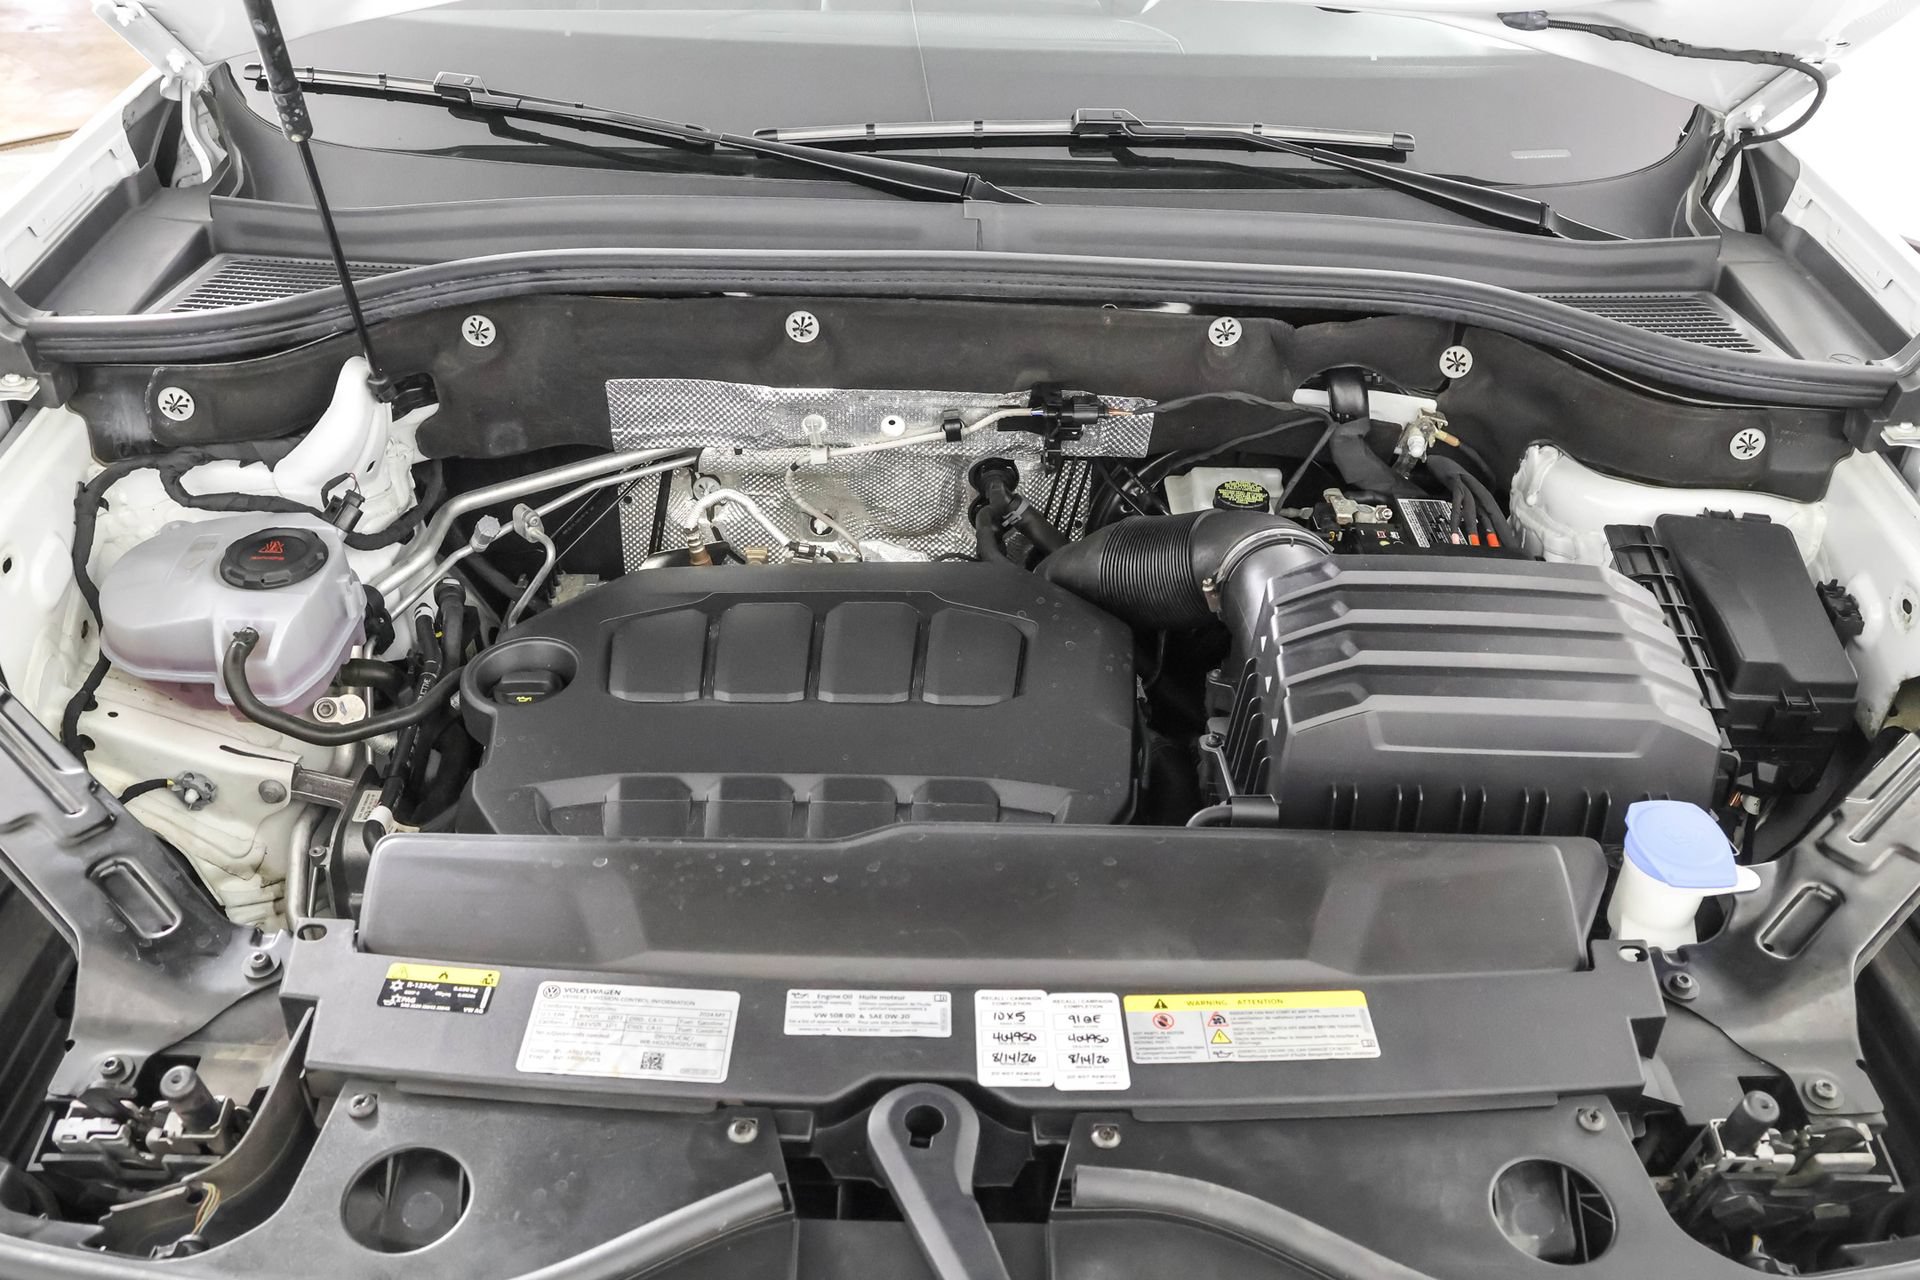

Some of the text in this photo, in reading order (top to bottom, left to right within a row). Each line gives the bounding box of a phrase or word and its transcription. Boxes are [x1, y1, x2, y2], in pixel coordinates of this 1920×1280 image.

[564, 987, 621, 996] VOLKSWAGEN
[816, 993, 841, 1001] Engine
[1236, 998, 1284, 1006] ATTENTION
